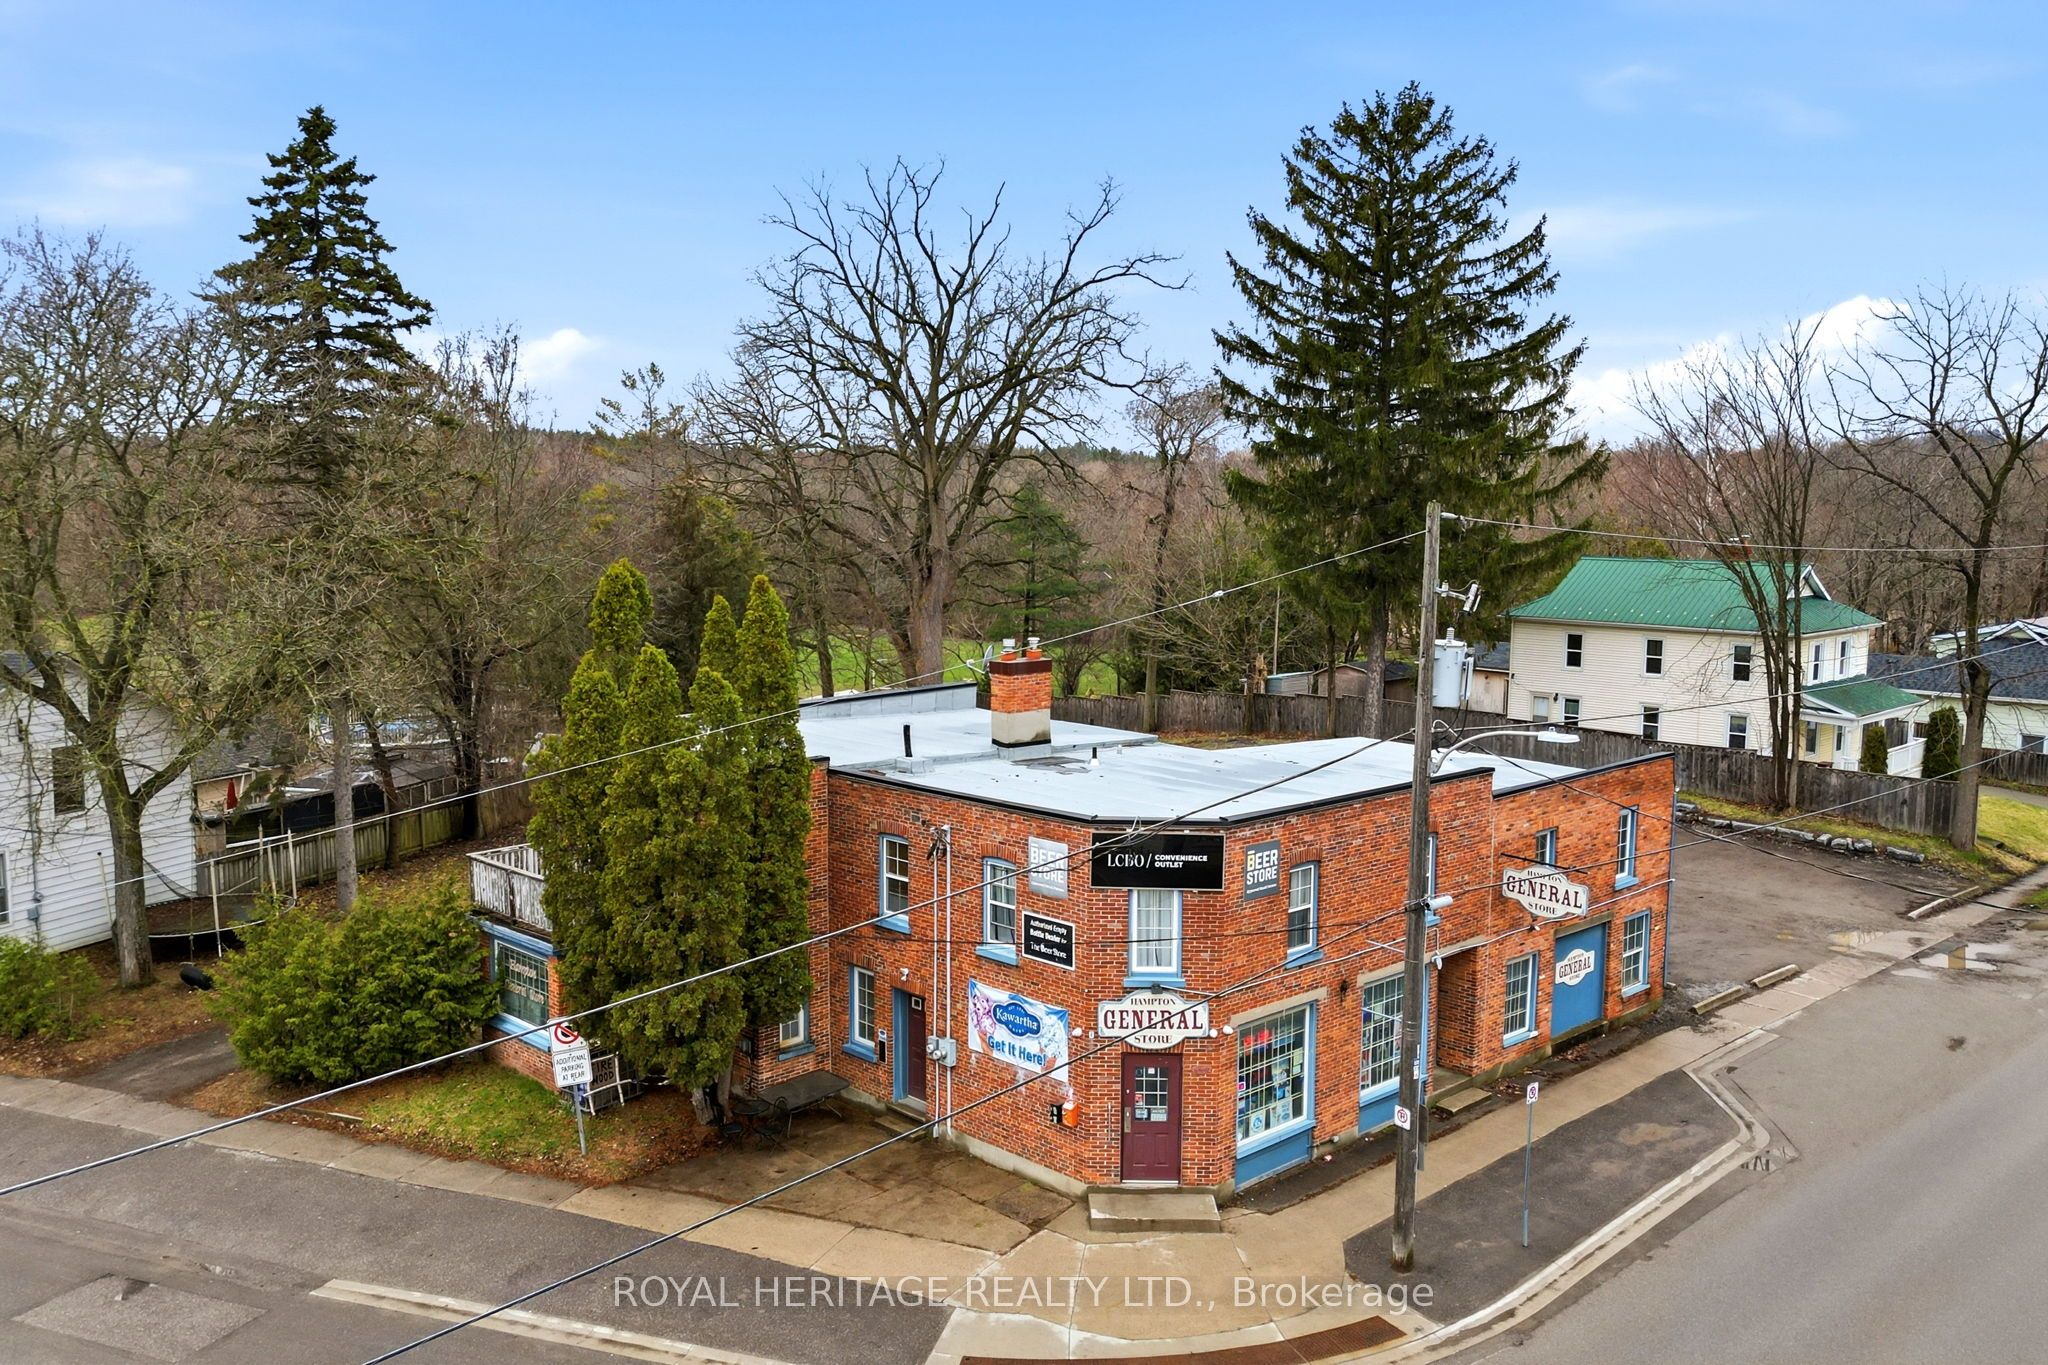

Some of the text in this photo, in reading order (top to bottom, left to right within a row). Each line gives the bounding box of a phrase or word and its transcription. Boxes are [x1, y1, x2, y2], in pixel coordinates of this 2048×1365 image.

[1030, 846, 1065, 869] BEER
[1107, 853, 1145, 868] LCBO
[1154, 854, 1208, 862] CONVENIENCE
[1247, 850, 1278, 871] BEER
[1246, 866, 1278, 885] STORE
[1506, 875, 1583, 909] GENERAL
[1528, 902, 1558, 915] STORE
[1559, 956, 1591, 978] GENERAL
[1130, 997, 1176, 1006] HAMPTON
[996, 1007, 1038, 1030] Kawartha
[1103, 1009, 1204, 1030] GENERAL
[1134, 1035, 1173, 1044] STORE
[556, 1053, 587, 1065] ADDITIONAL
[988, 1035, 1047, 1067] Get It Here!
[561, 1063, 584, 1073] PARKING
[570, 1071, 585, 1080] REAR
